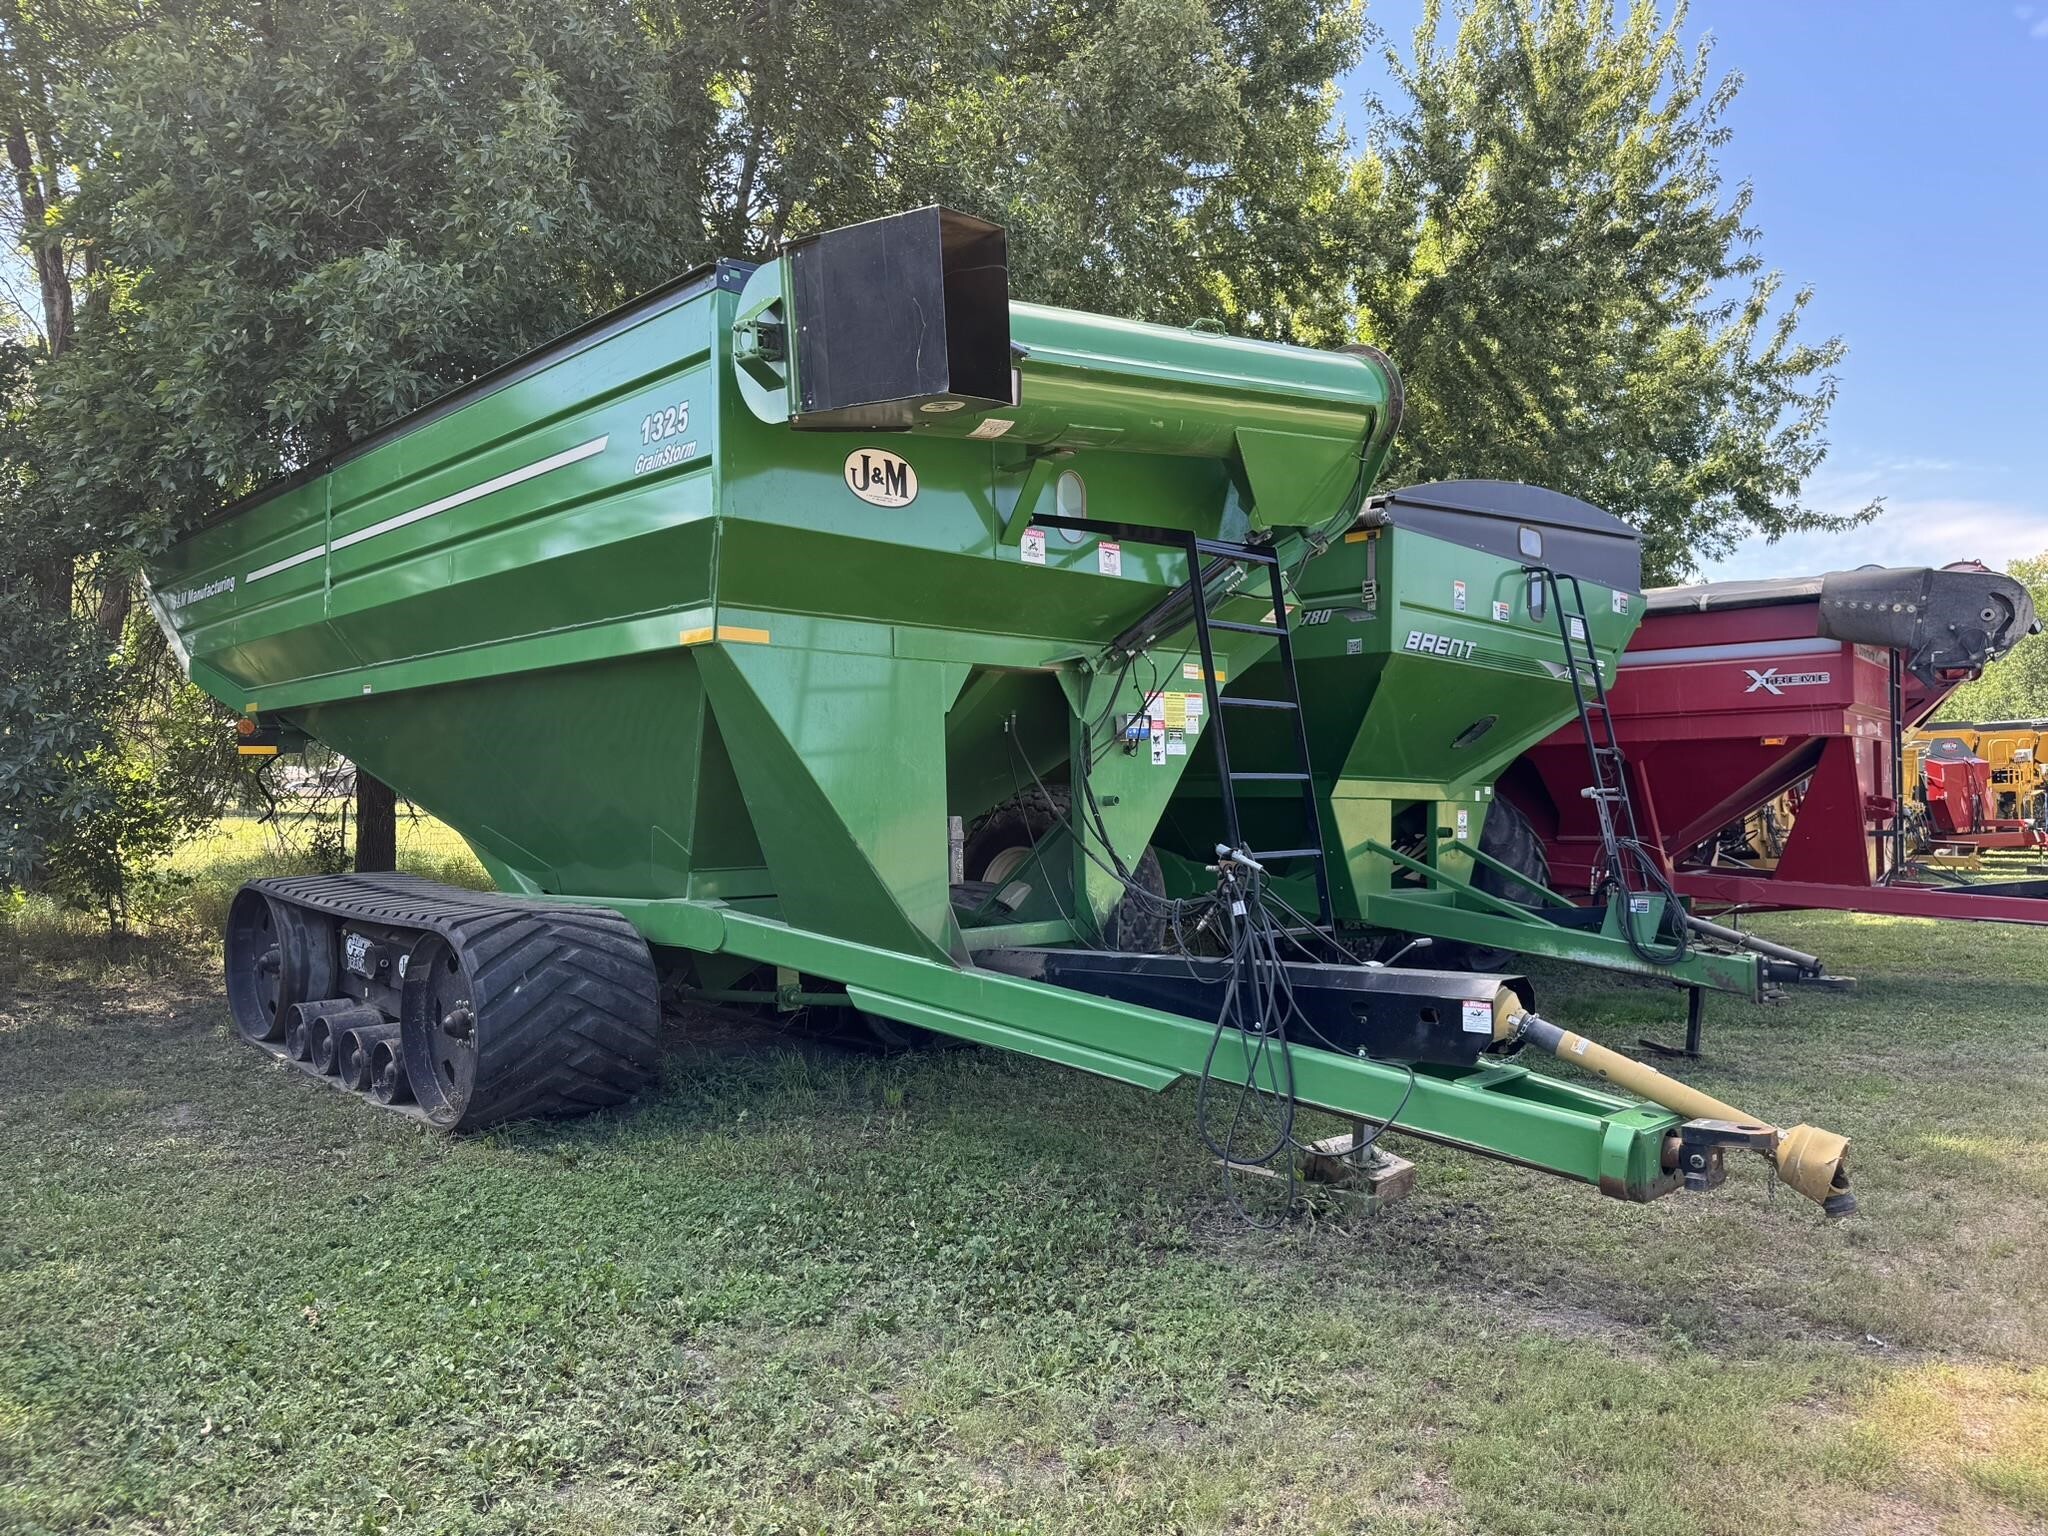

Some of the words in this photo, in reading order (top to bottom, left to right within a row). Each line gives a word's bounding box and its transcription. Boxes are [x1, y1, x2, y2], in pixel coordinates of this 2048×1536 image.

[641, 400, 689, 446] 1325
[634, 440, 697, 475] GrainStorm
[850, 454, 909, 499] J&M
[187, 576, 235, 604] Manufacturing
[1301, 609, 1332, 626] 780
[1404, 630, 1477, 659] BRENT
[1742, 667, 1830, 696] XTREME
